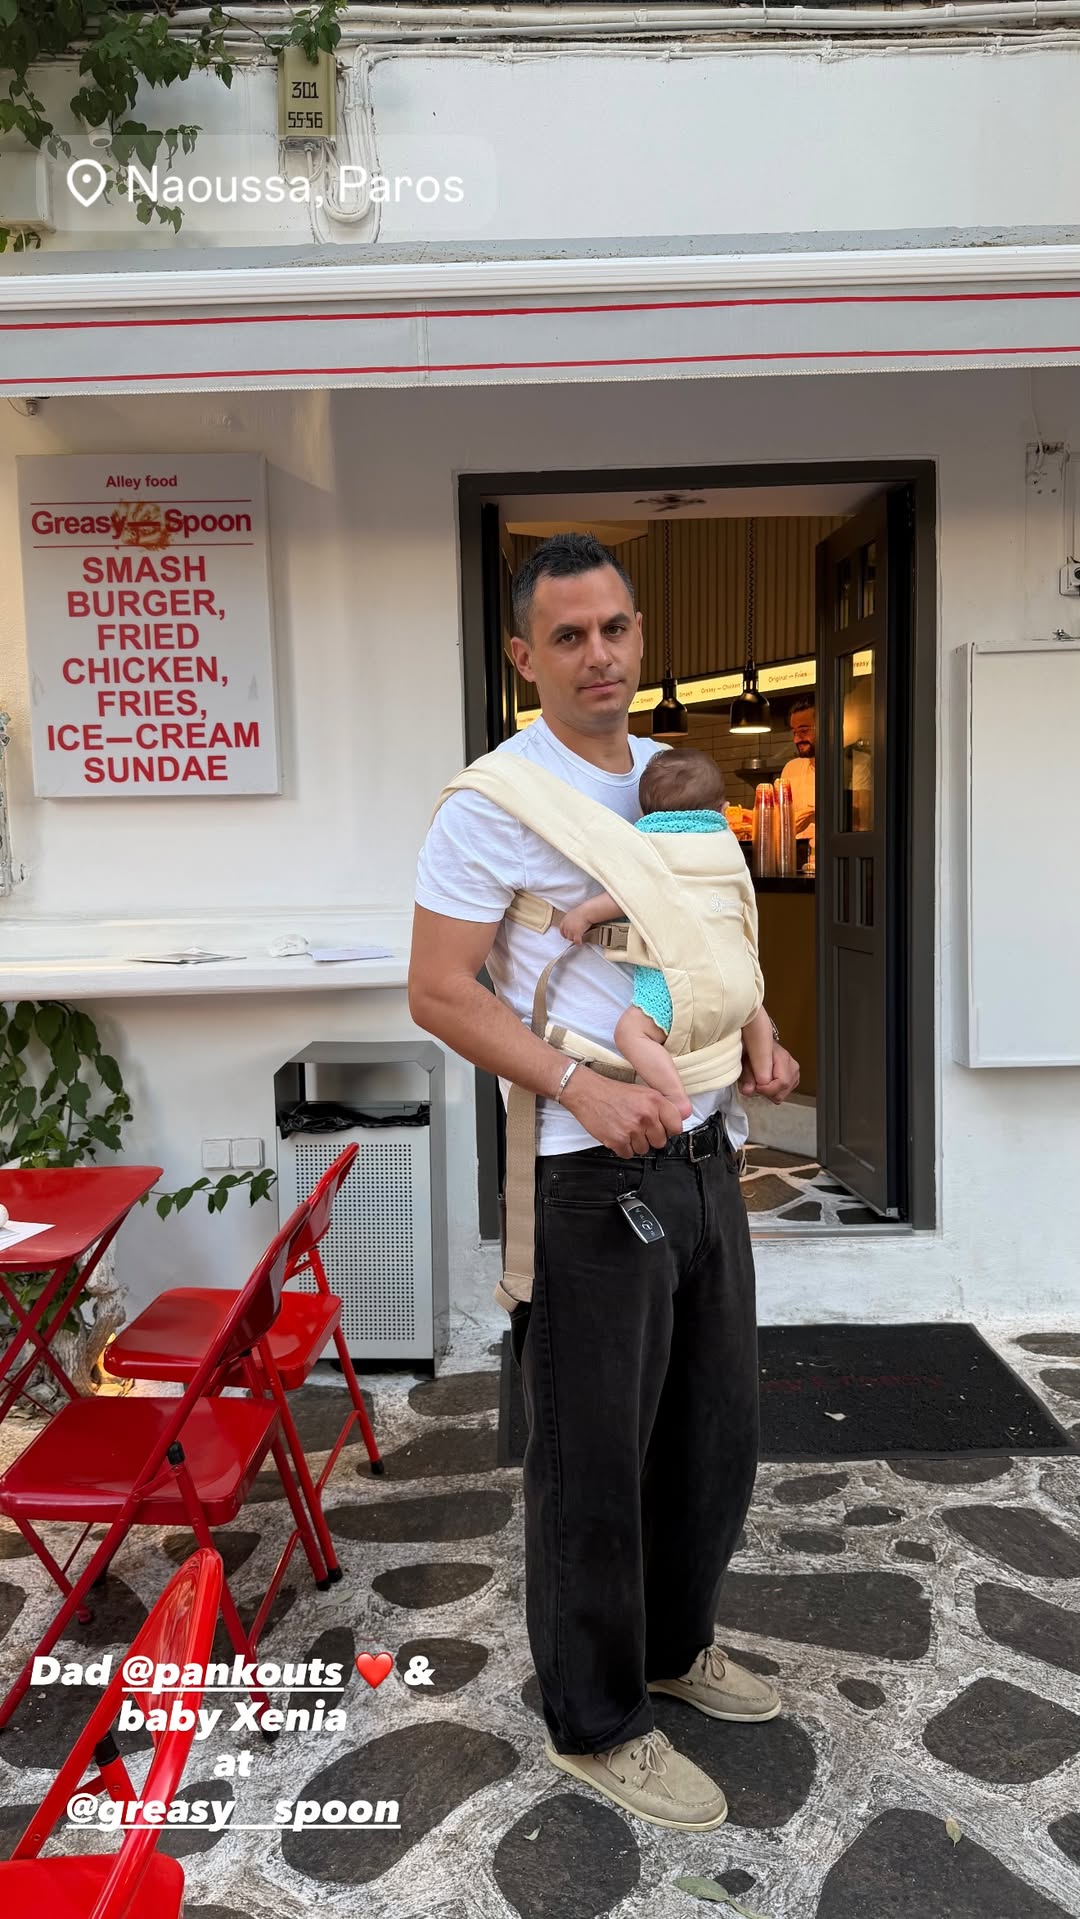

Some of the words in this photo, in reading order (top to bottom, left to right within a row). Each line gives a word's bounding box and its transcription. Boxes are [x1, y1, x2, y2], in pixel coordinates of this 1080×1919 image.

[291, 81, 319, 99] 301
[106, 475, 142, 490] Alley
[145, 475, 178, 488] food
[82, 556, 207, 584] SMASH
[67, 590, 226, 620] BURGER,
[97, 623, 200, 651] FRIED
[62, 657, 229, 687] CHICKEN,
[768, 675, 788, 683] Original
[97, 690, 207, 720] FRIES,
[84, 756, 229, 783] SUNDAE
